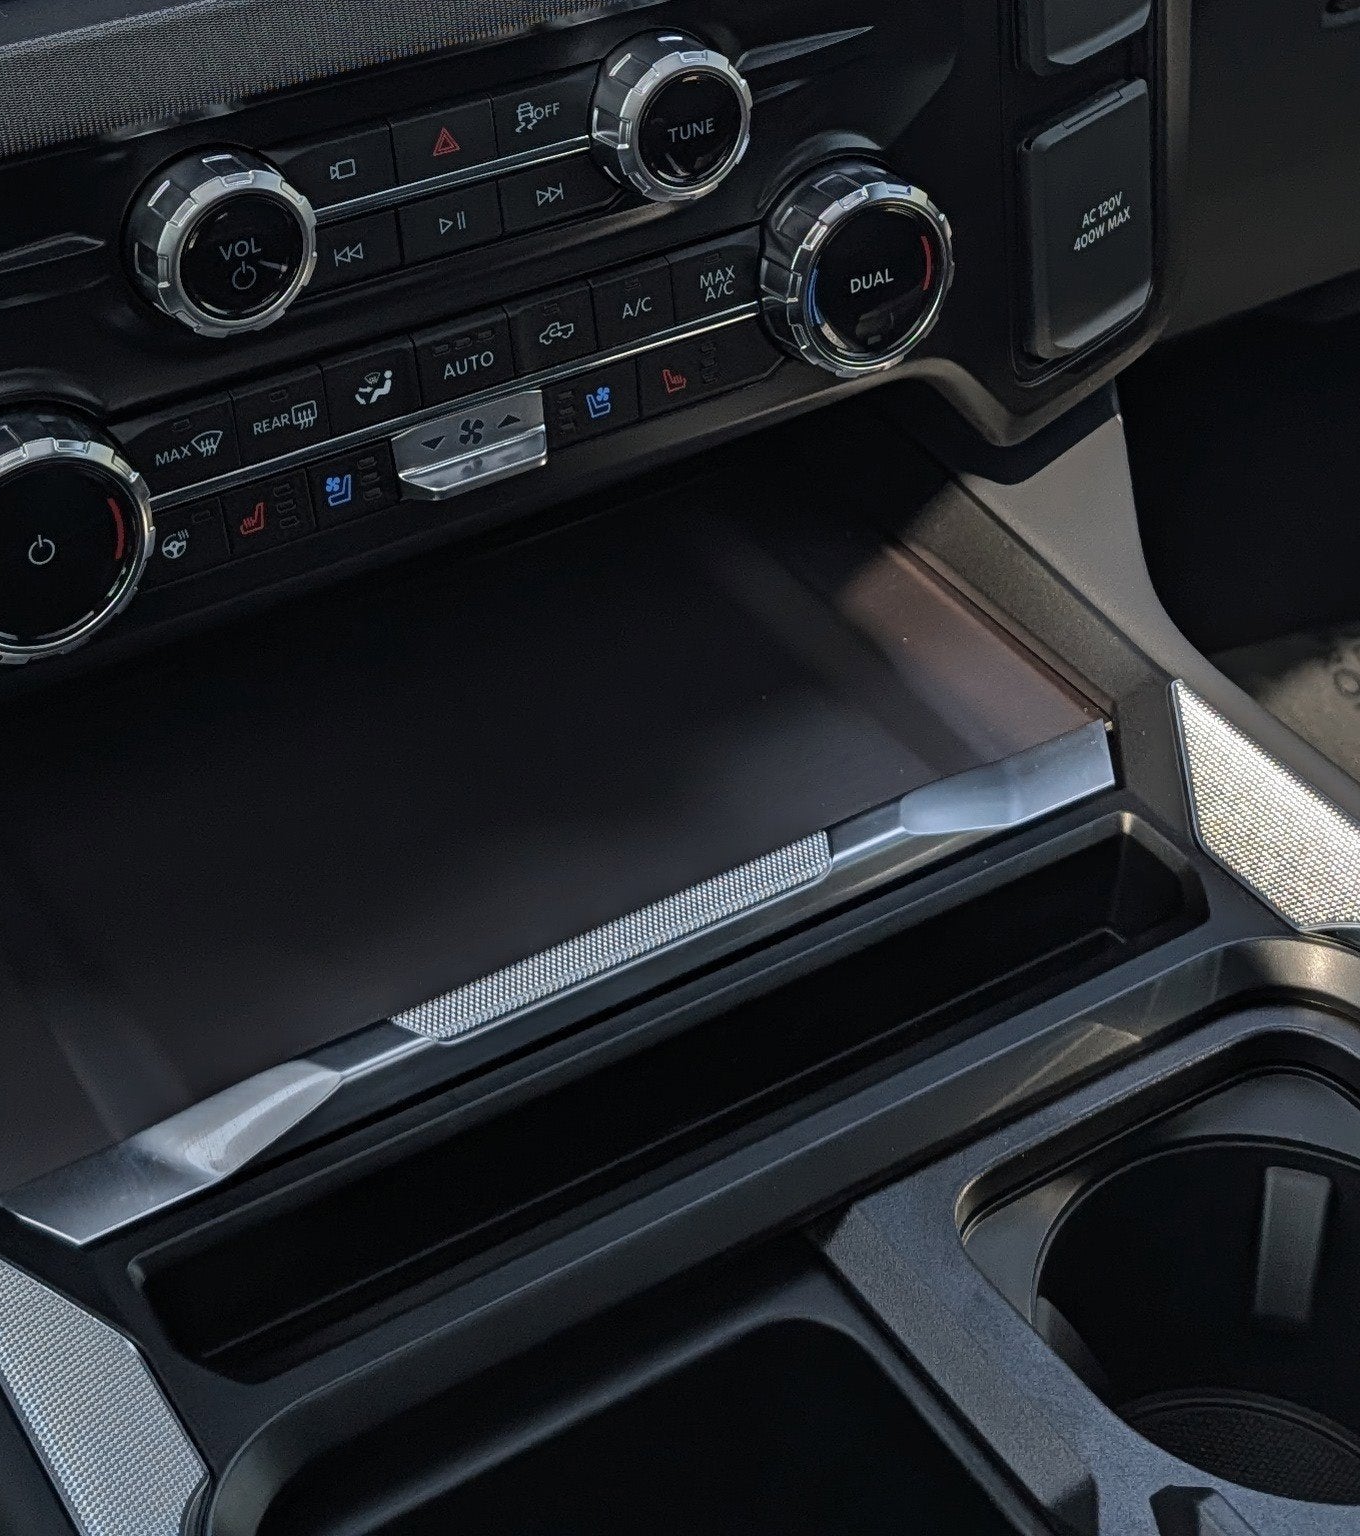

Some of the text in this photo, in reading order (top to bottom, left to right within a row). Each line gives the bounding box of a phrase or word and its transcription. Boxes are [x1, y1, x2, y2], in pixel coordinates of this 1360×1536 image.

[535, 101, 560, 119] OFF
[668, 118, 715, 142] TUNE
[1082, 192, 1123, 228] AC 120V
[1073, 206, 1131, 252] 400W MAX
[219, 238, 262, 261] VOL
[700, 266, 736, 289] MAX
[850, 268, 894, 293] DUAL
[704, 281, 735, 303] A/C
[622, 297, 652, 319] A/C
[444, 352, 494, 379] AUTO
[252, 412, 290, 435] REAR
[155, 443, 191, 466] MAX
